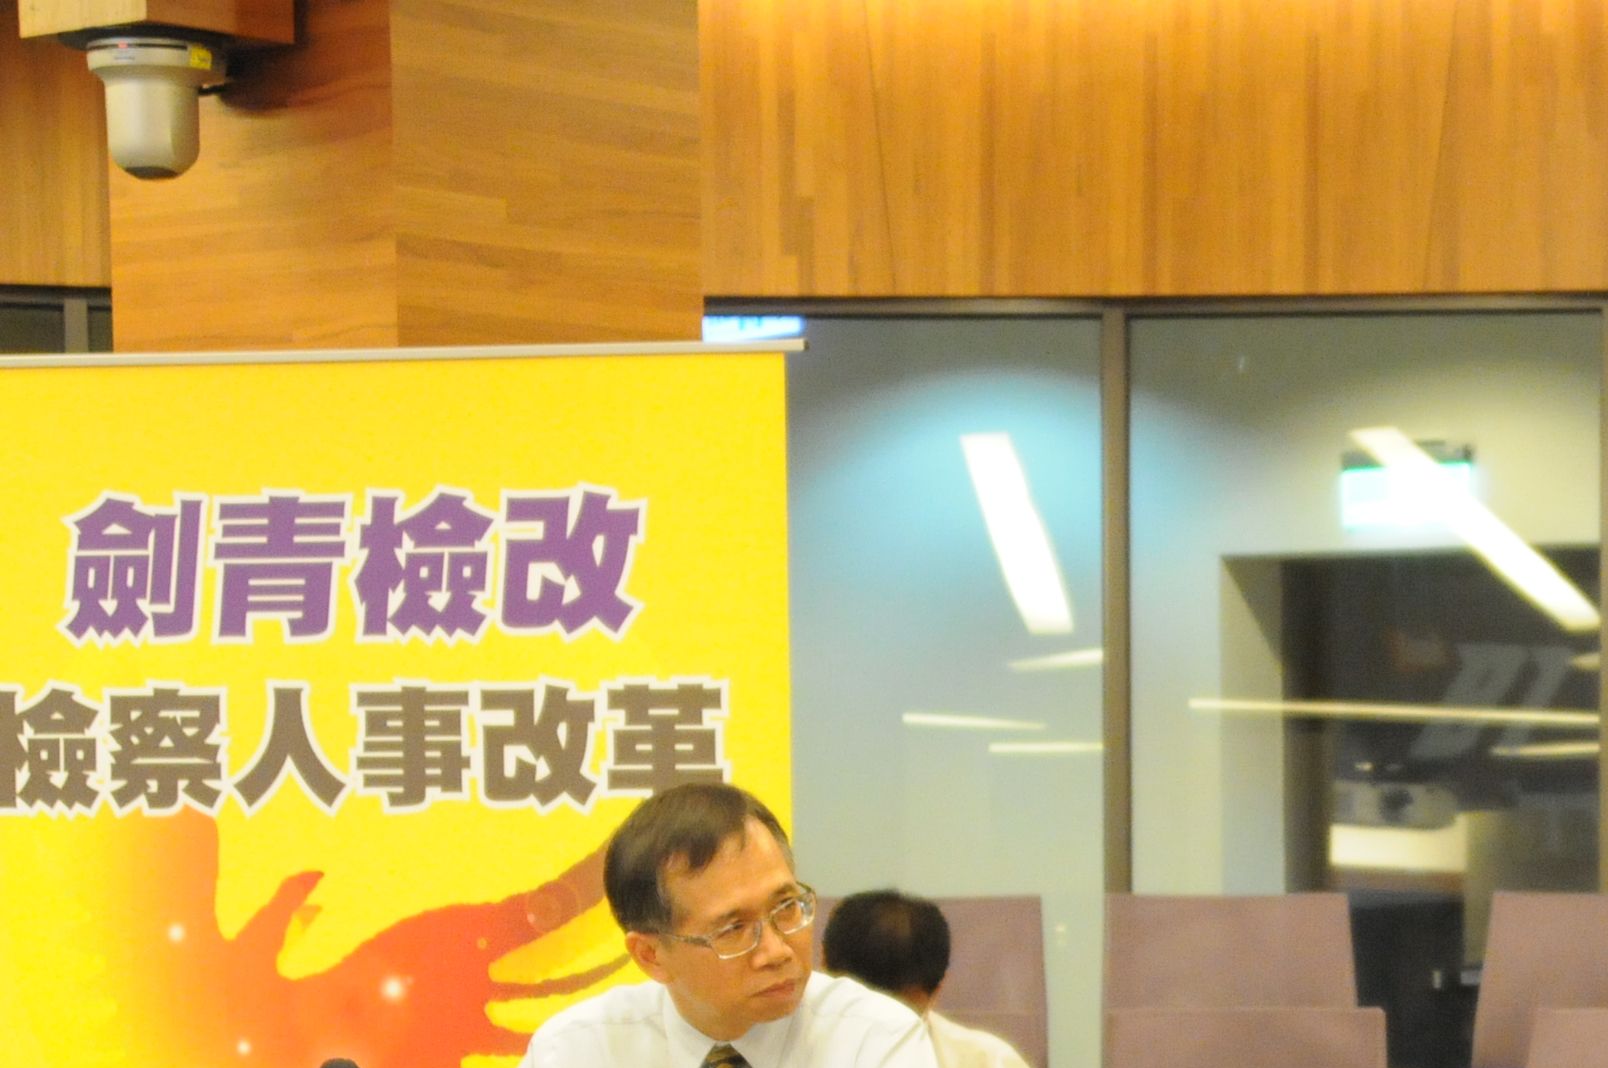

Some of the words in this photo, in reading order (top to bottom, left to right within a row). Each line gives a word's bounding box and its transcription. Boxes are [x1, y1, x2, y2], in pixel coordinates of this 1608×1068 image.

[62, 484, 645, 644] 劍青檢改
[0, 679, 728, 815] 檢察人事改革
